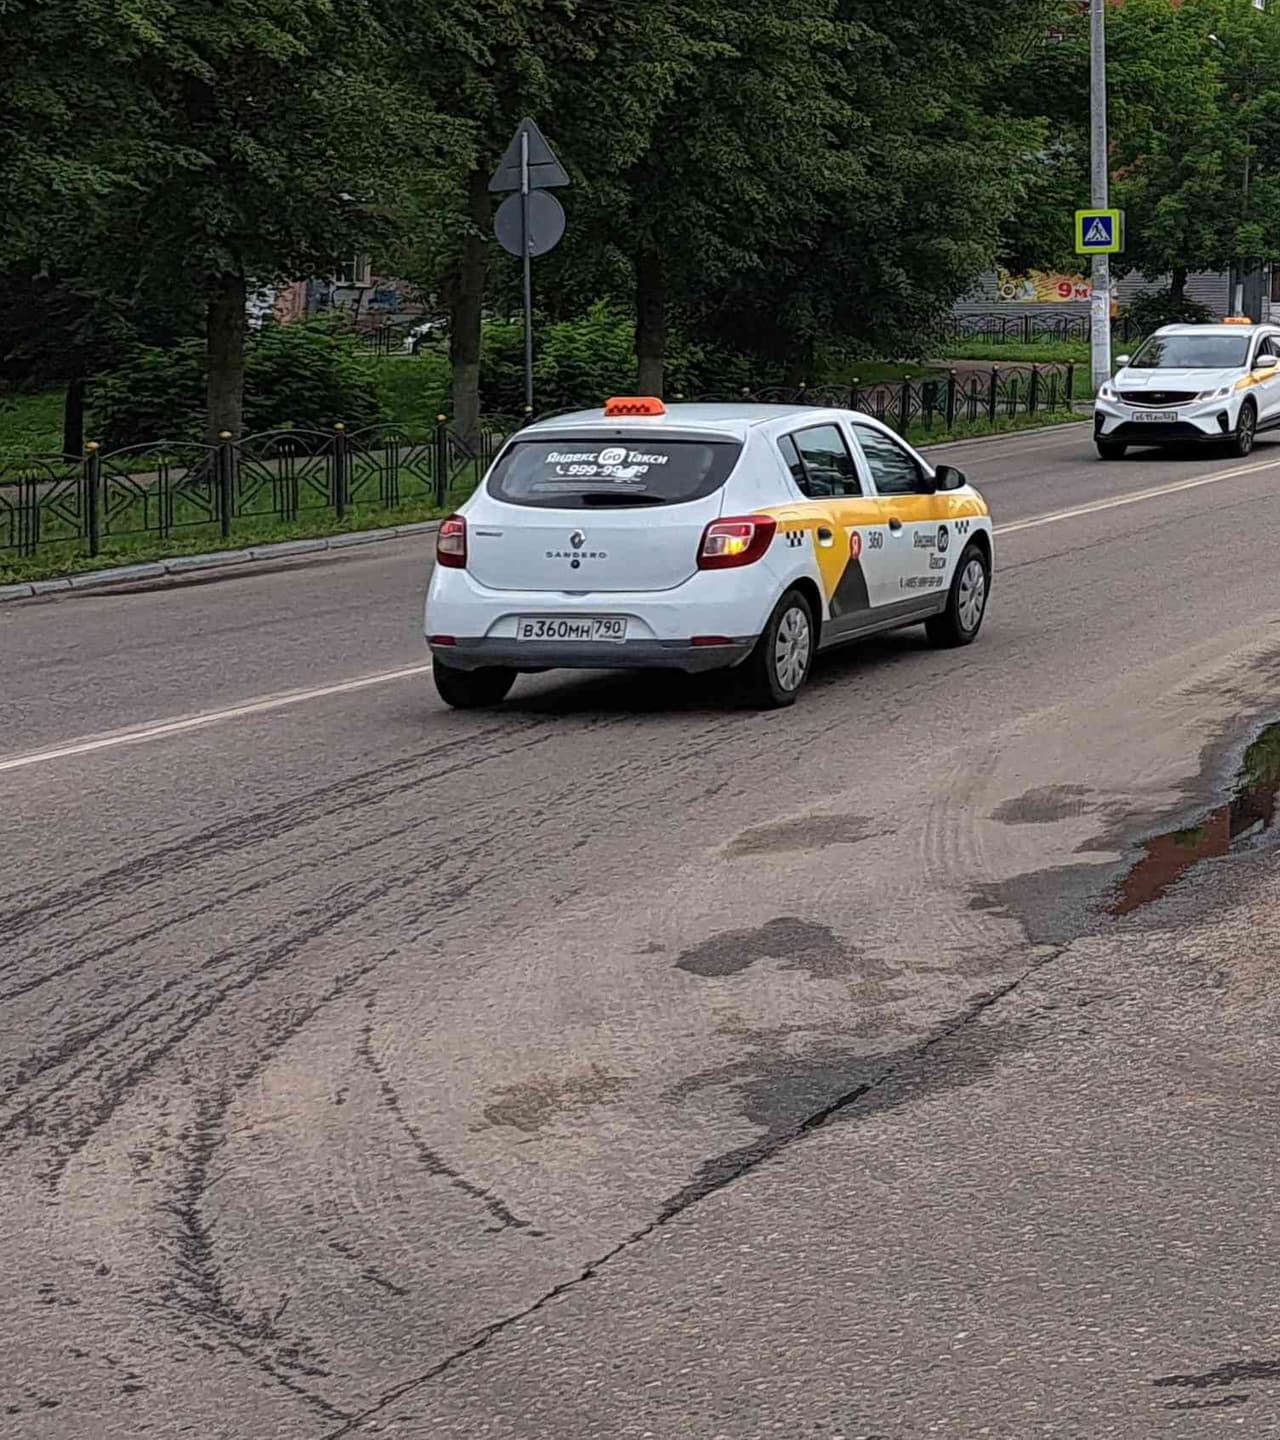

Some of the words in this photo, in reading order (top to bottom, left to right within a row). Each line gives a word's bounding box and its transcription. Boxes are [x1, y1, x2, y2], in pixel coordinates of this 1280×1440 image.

[1058, 281, 1073, 298] 9
[627, 451, 668, 464] Такси
[545, 551, 607, 559] SANDERO
